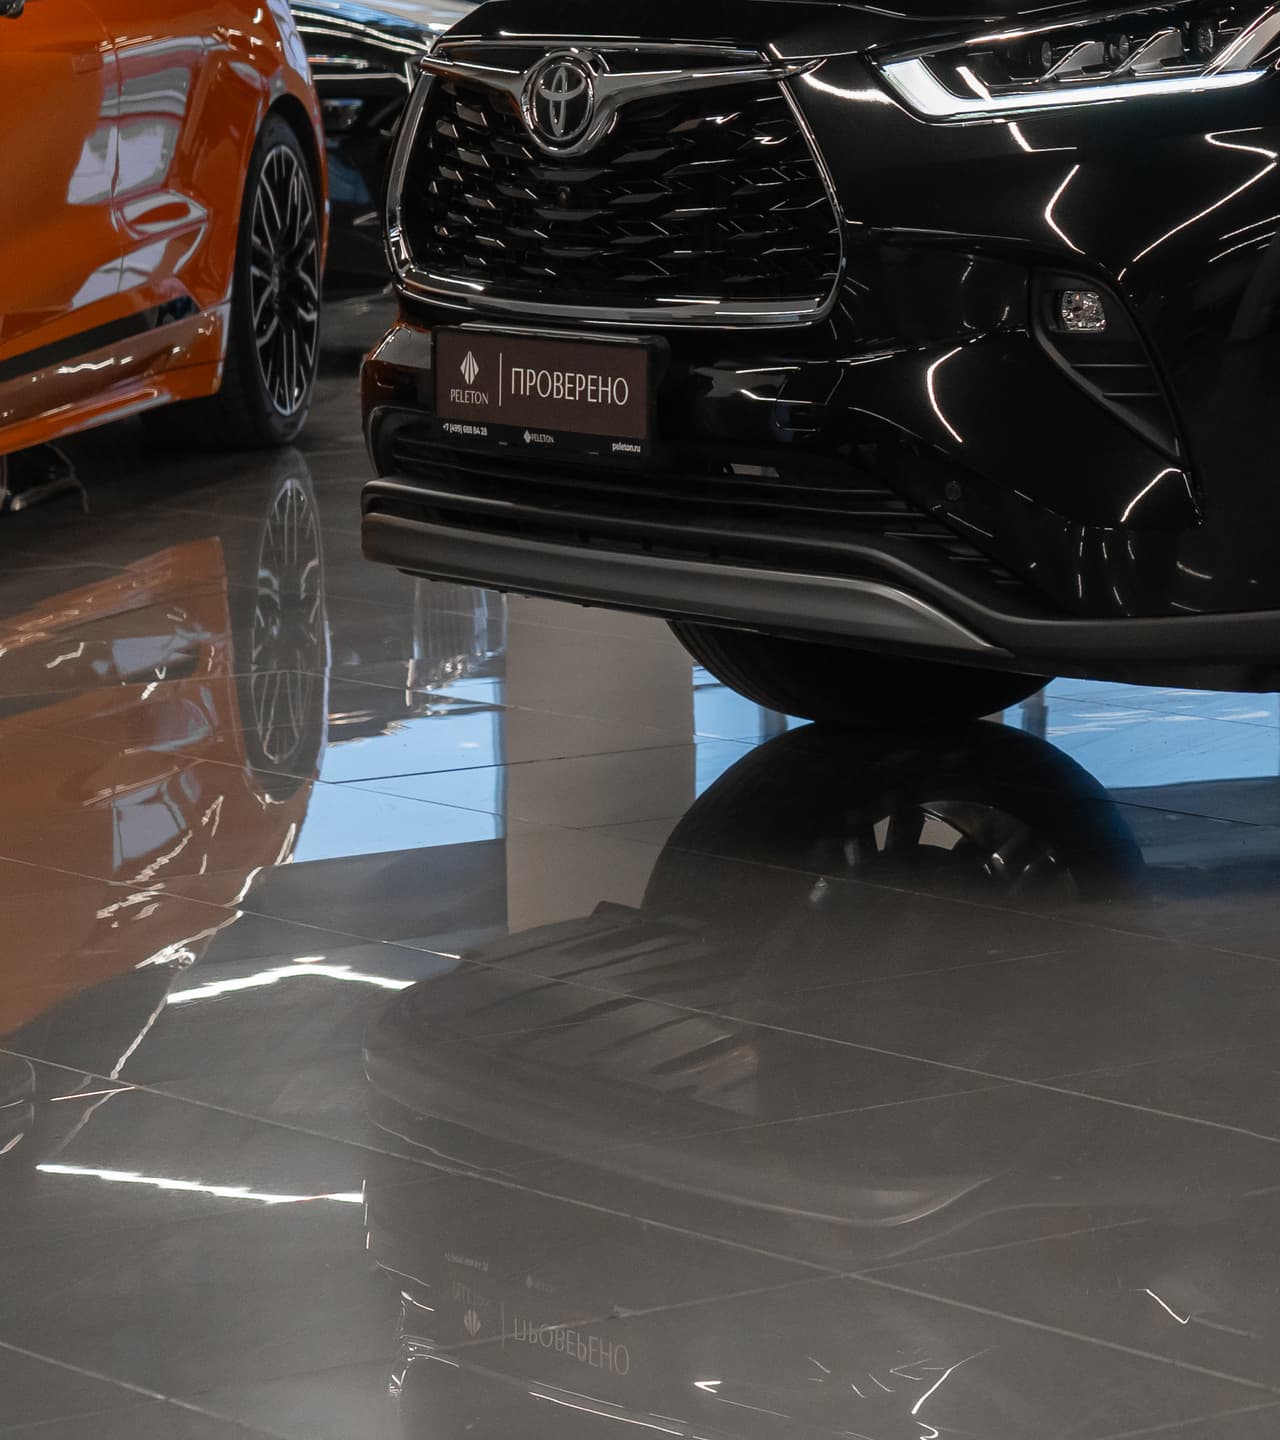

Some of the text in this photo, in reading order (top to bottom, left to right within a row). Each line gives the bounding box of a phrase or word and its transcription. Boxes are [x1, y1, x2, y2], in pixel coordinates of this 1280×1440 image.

[511, 367, 629, 406] ПРОВЕРЕНО
[450, 388, 489, 406] PELETON
[531, 432, 555, 444] PELETON
[612, 441, 641, 453] peleton.ru
